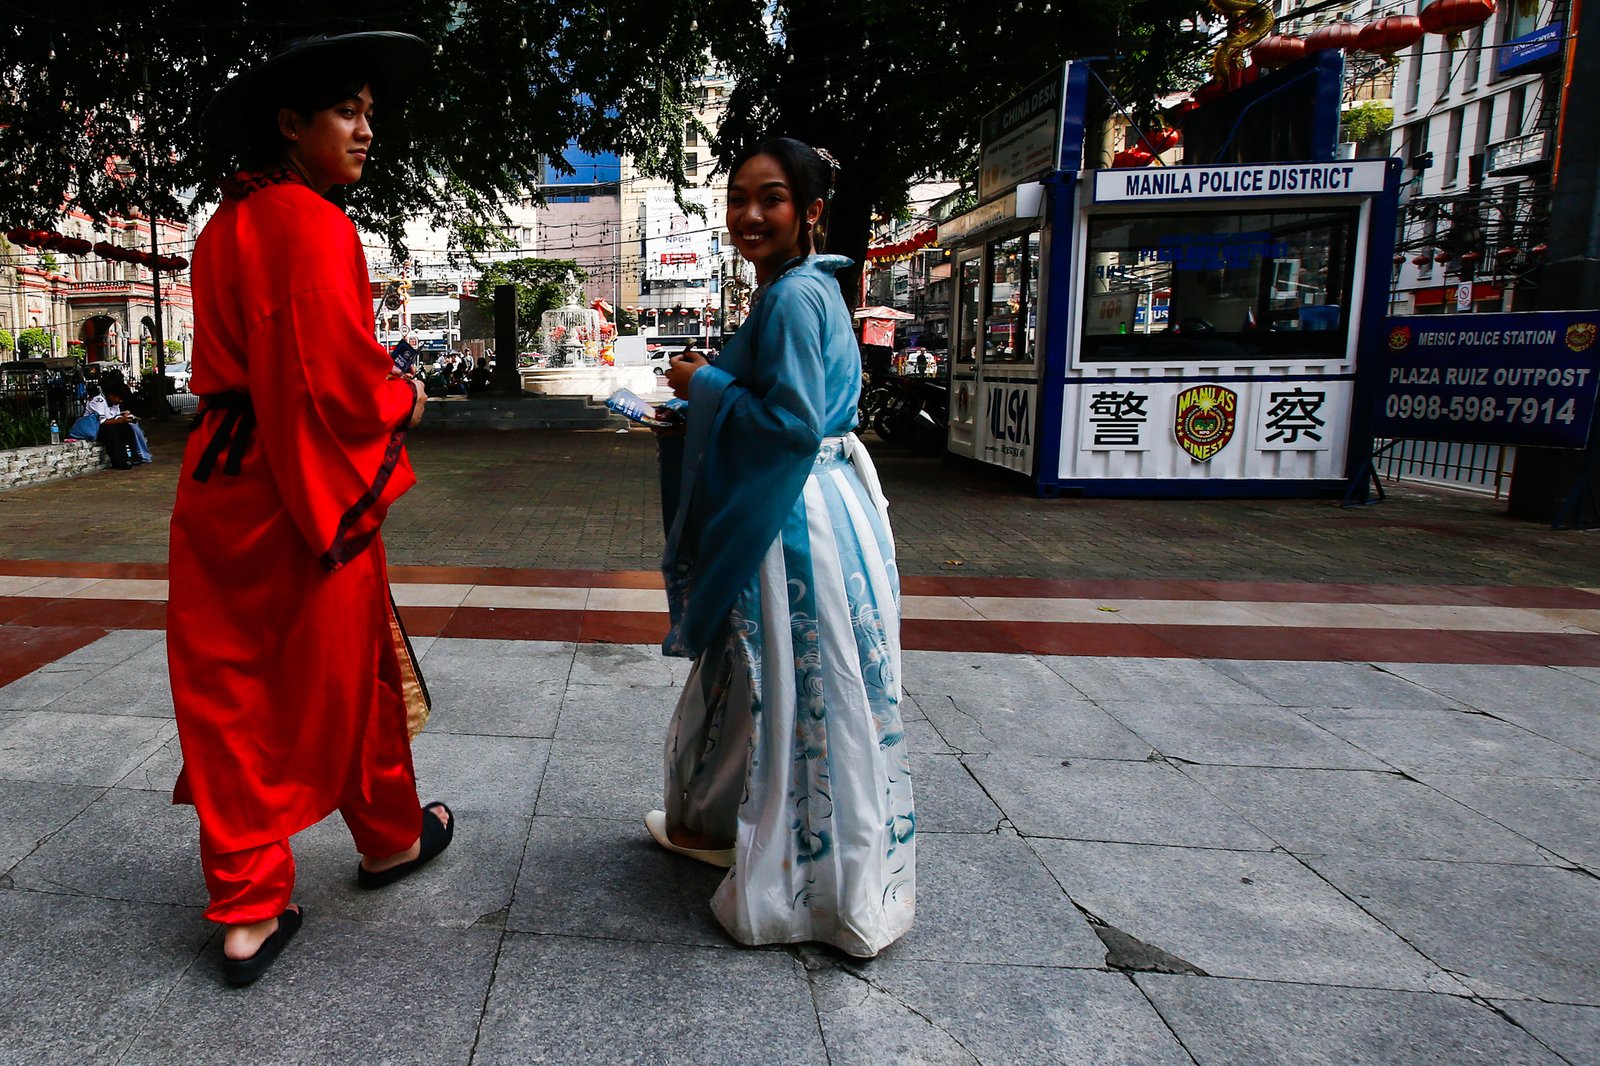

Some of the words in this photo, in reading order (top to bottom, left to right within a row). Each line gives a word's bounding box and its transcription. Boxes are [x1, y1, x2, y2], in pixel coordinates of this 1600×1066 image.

[1002, 104, 1030, 129] CHINA
[1031, 81, 1057, 111] DESK
[1126, 173, 1193, 196] MANILA
[1199, 170, 1263, 193] POLICE
[1269, 167, 1354, 191] DISTRICT
[1418, 331, 1456, 346] MEISIC
[1458, 331, 1500, 345] POLICE
[1502, 330, 1556, 345] STATION
[1389, 367, 1440, 384] PLAZA
[1445, 368, 1489, 385] RUIZ
[1493, 368, 1590, 387] OUTPOST
[1089, 390, 1149, 446] 警
[1265, 387, 1326, 444] 察
[1178, 387, 1235, 417] MANILA'S
[1385, 394, 1576, 425] 0998-598-7914
[1183, 438, 1225, 459] FINEST
